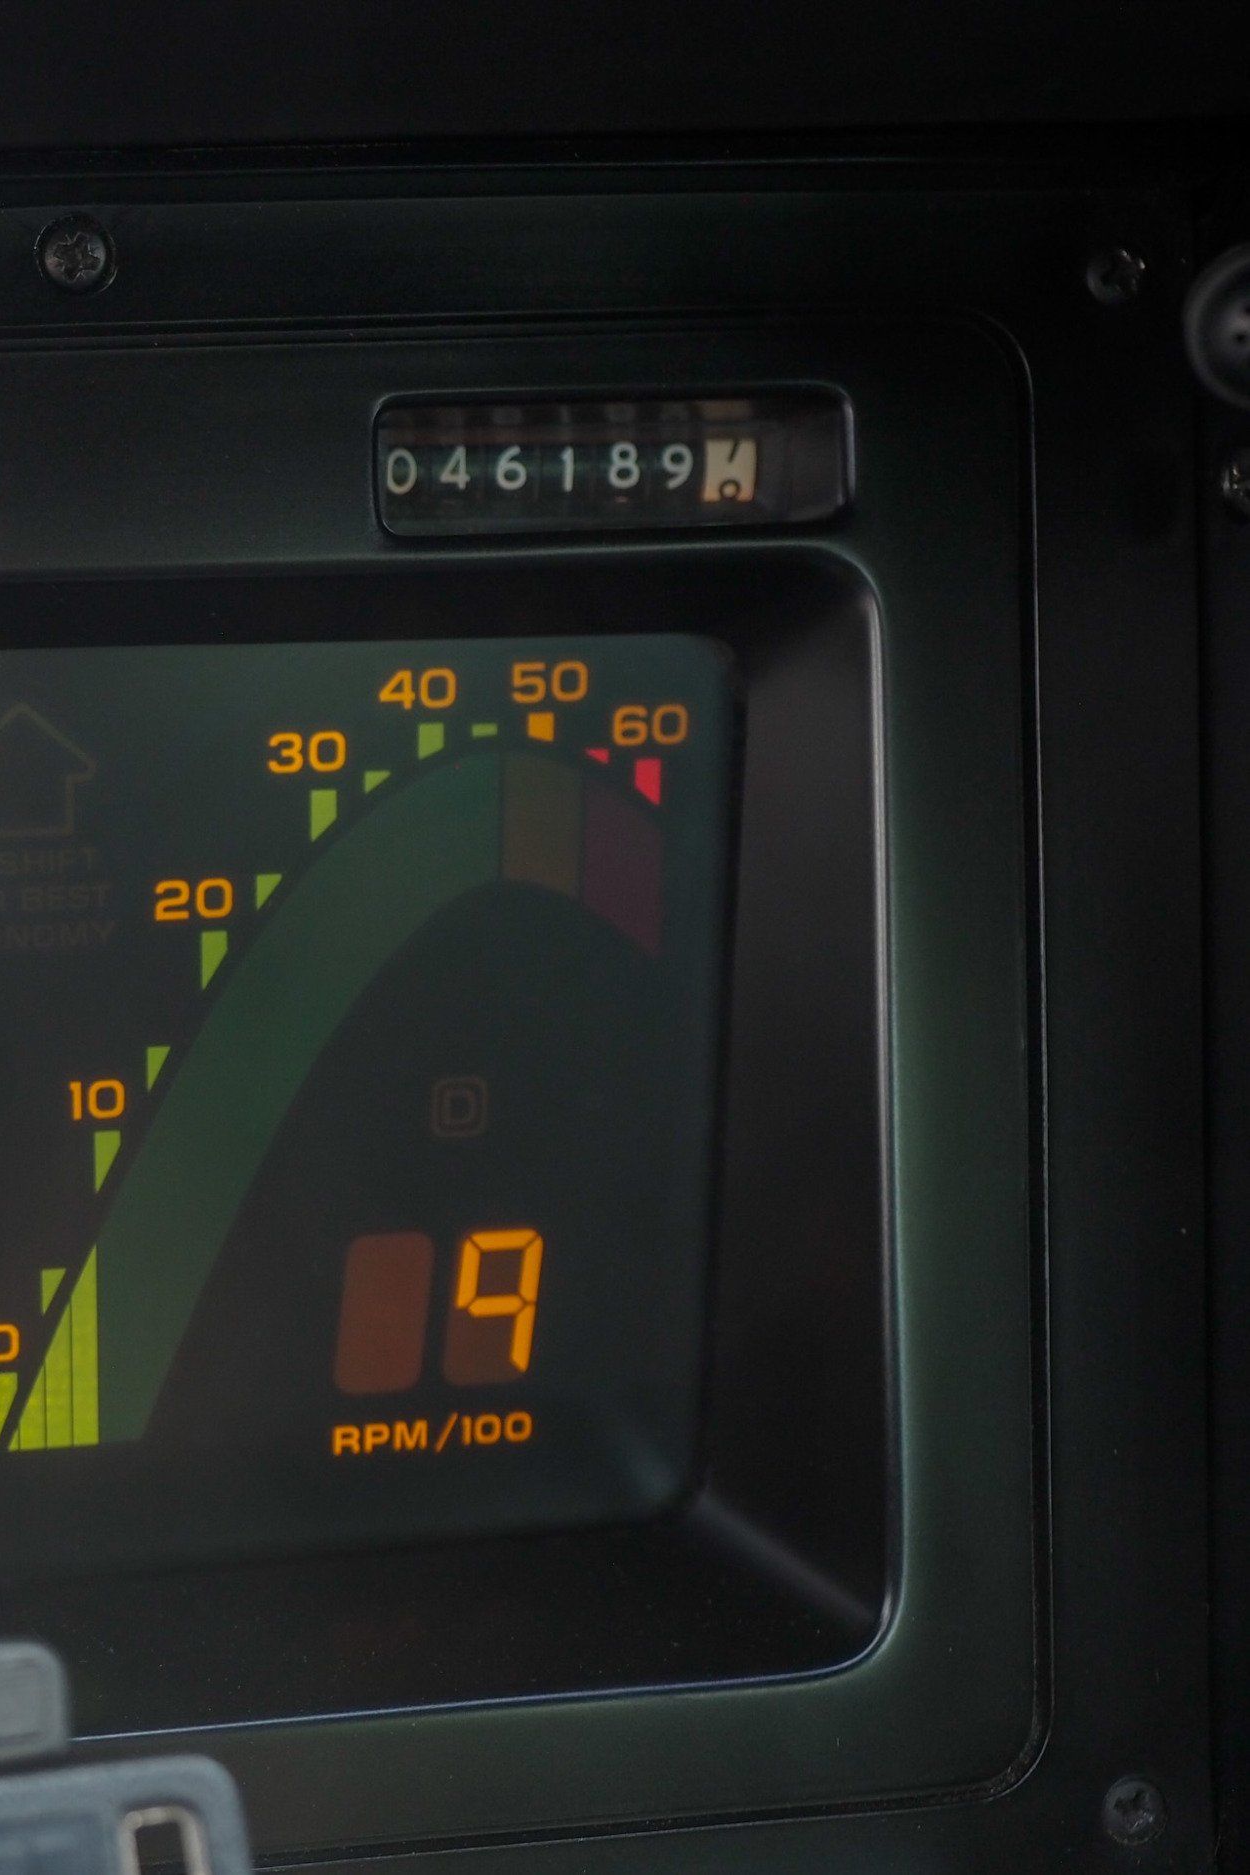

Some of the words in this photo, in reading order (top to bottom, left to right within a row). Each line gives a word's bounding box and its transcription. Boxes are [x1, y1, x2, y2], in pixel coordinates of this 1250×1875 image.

[378, 669, 457, 708] 40
[513, 661, 588, 703] 50
[612, 705, 687, 746] 60
[268, 731, 347, 773] 30
[21, 882, 112, 911] BEST
[154, 878, 234, 922] 20
[69, 1079, 126, 1120] 10
[442, 1087, 478, 1127] D
[456, 1229, 543, 1371] 9
